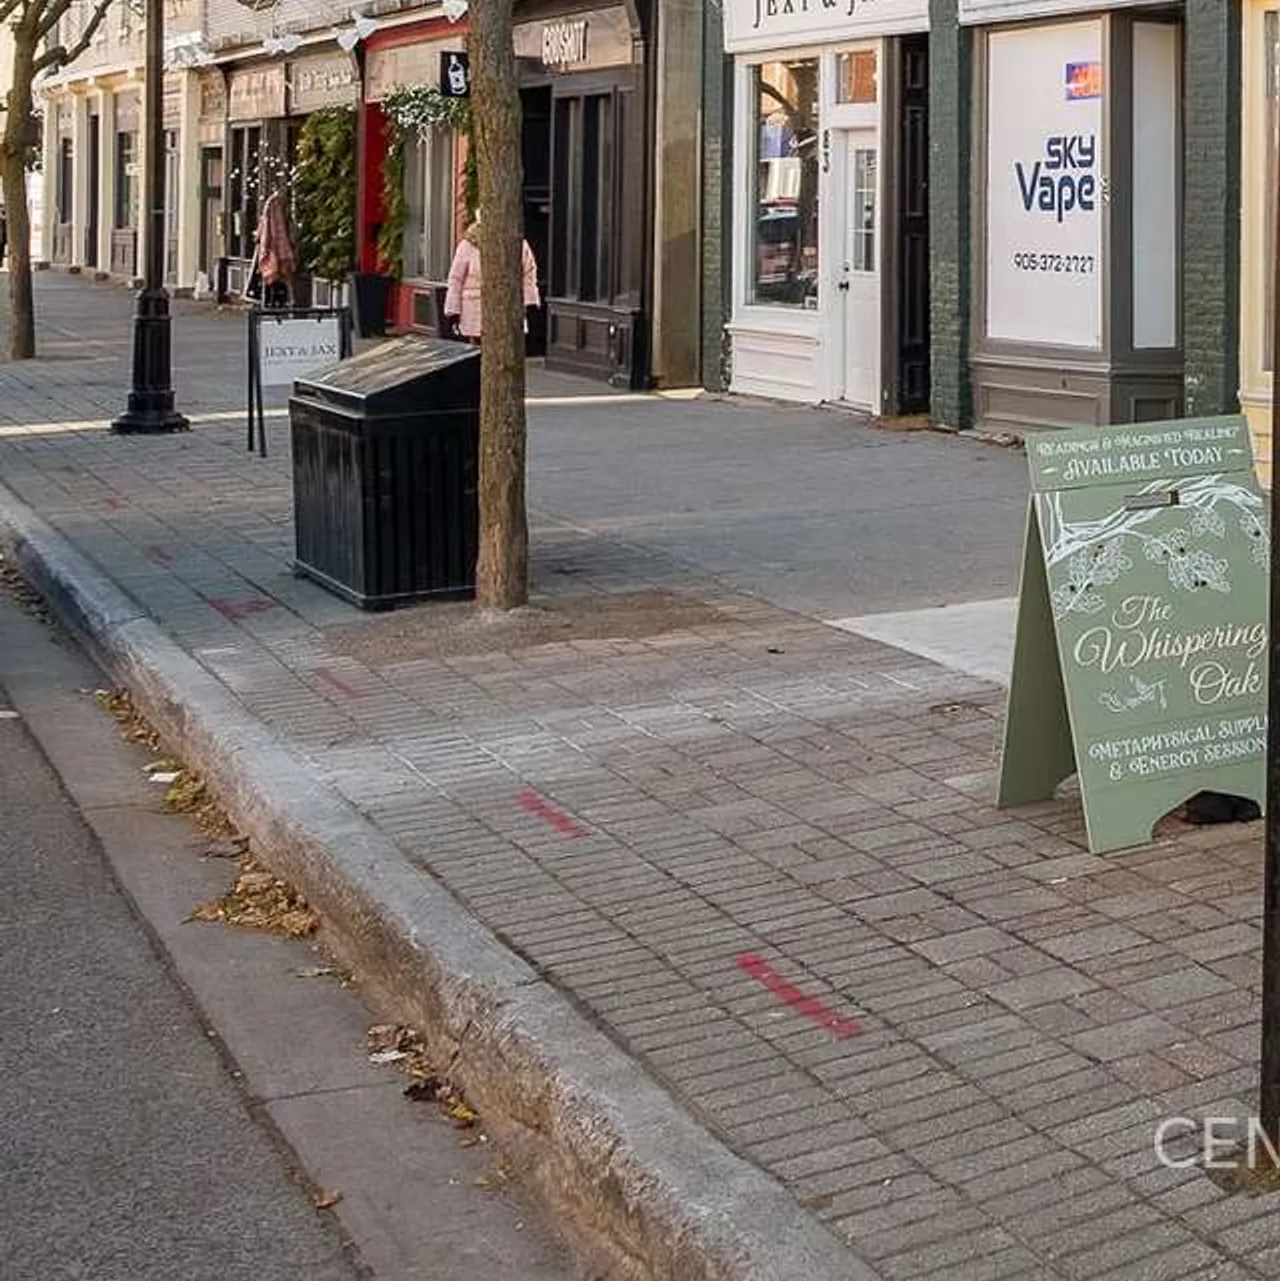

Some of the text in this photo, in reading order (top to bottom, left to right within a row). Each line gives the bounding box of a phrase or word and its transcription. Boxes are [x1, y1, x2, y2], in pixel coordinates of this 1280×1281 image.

[1045, 134, 1096, 169] SKY
[1015, 161, 1095, 224] Vape
[1062, 446, 1224, 481] AVAILABLE TODAY
[1111, 594, 1173, 630] The
[1074, 622, 1269, 675] Whispering
[1189, 660, 1264, 705] Oak
[1088, 724, 1216, 761] METAPHYSICAL
[1109, 736, 1268, 781] & ENERGY SESSION
